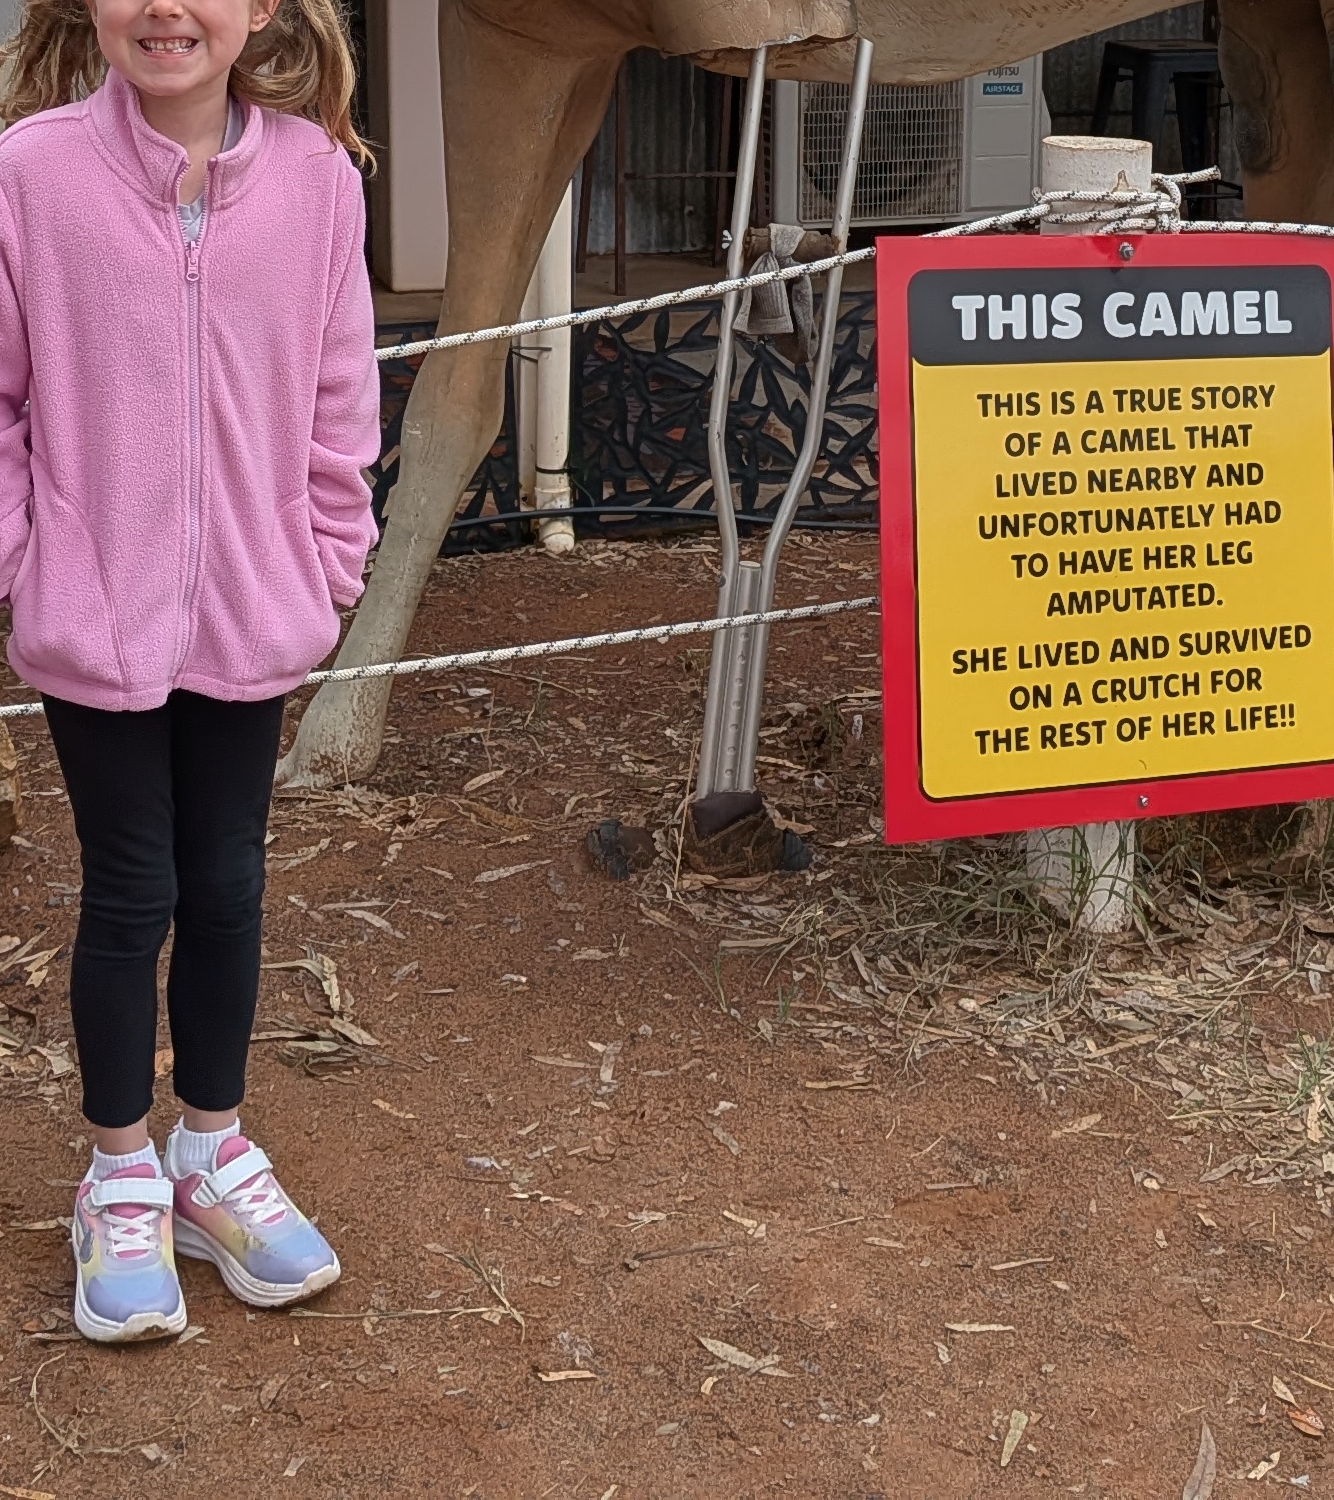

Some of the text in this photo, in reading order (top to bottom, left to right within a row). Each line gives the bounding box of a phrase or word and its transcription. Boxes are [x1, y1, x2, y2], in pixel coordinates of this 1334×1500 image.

[985, 85, 1021, 93] AIRSTAGE
[988, 66, 1020, 78] FUJITSU
[951, 290, 1293, 341] THIS CAMEL
[976, 384, 1275, 418] THIS IS A TRUE STORY
[1004, 424, 1253, 457] OF A CAMEL THAT
[996, 462, 1264, 498] LIVED NEARBY AND
[978, 500, 1281, 540] UNFORTUNATELY HAD
[1010, 540, 1253, 578] TO HAVE HER LEG
[1046, 582, 1223, 617] AMPUTATED.
[952, 624, 1312, 675] SHE LIVED AND SURVIVED
[1009, 667, 1262, 711] ON A CRUTCH FOR
[974, 703, 1296, 755] THE REST OF HER LIFE!!
